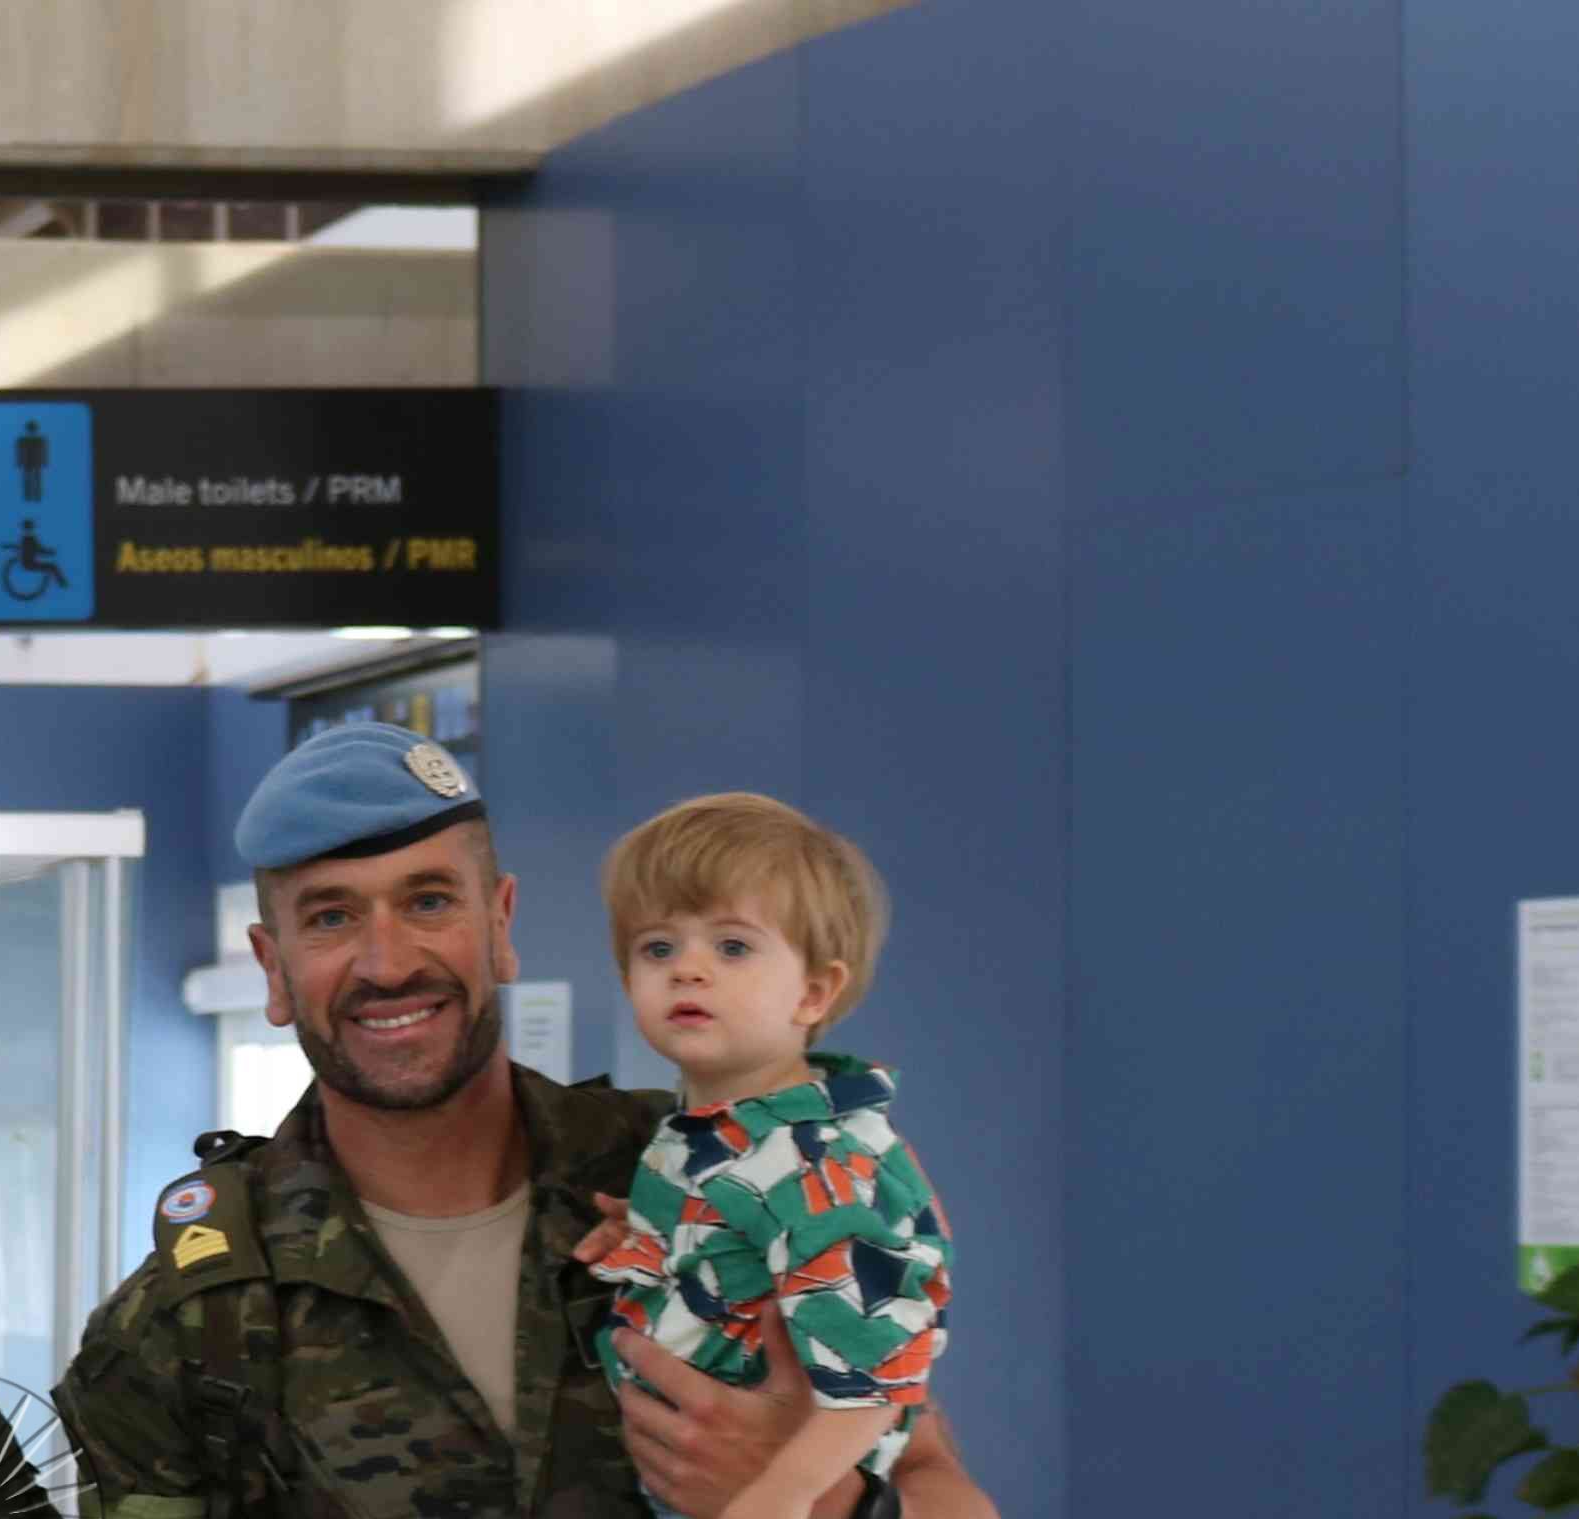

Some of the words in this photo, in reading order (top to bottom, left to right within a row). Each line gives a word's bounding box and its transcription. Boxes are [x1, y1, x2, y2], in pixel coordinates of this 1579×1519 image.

[115, 476, 193, 505] Male
[197, 476, 297, 506] toilets
[302, 476, 319, 504] /
[327, 475, 403, 504] PRM
[116, 541, 204, 572] Aseos
[209, 537, 374, 571] masculinos
[384, 538, 402, 569] /
[406, 538, 477, 571] PMR
